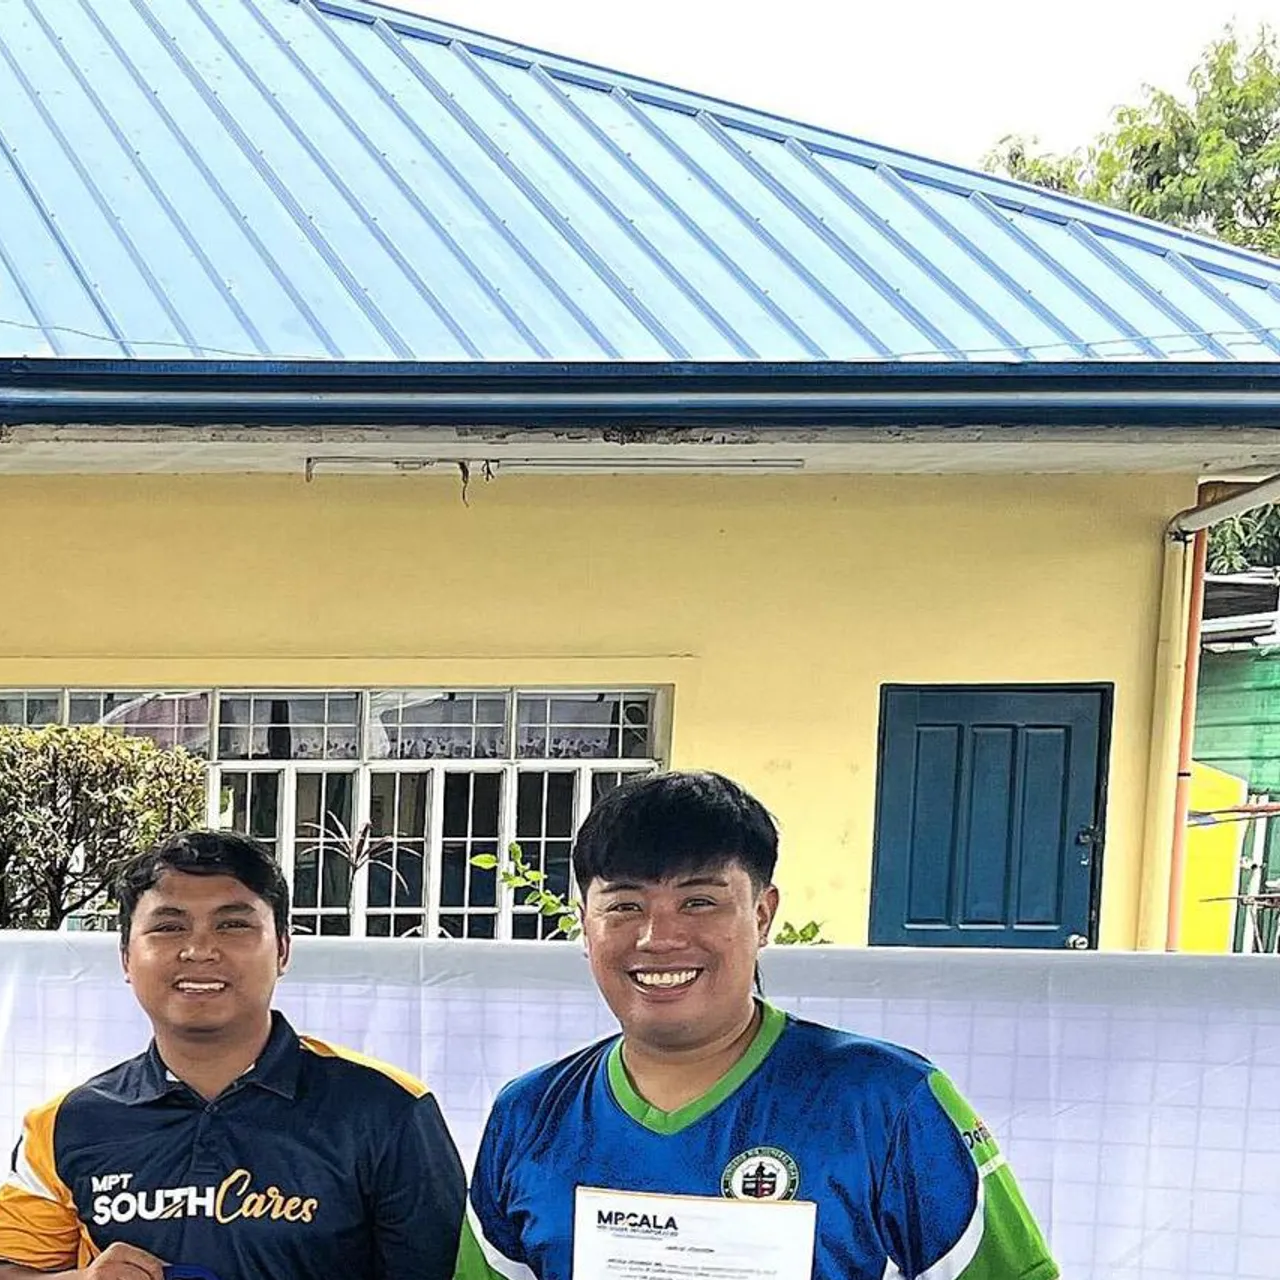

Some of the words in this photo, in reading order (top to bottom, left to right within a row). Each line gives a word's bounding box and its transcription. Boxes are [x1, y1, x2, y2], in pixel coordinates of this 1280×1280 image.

[92, 1173, 133, 1192] MPT
[92, 1185, 216, 1226] SOUTH
[214, 1168, 318, 1225] Cares
